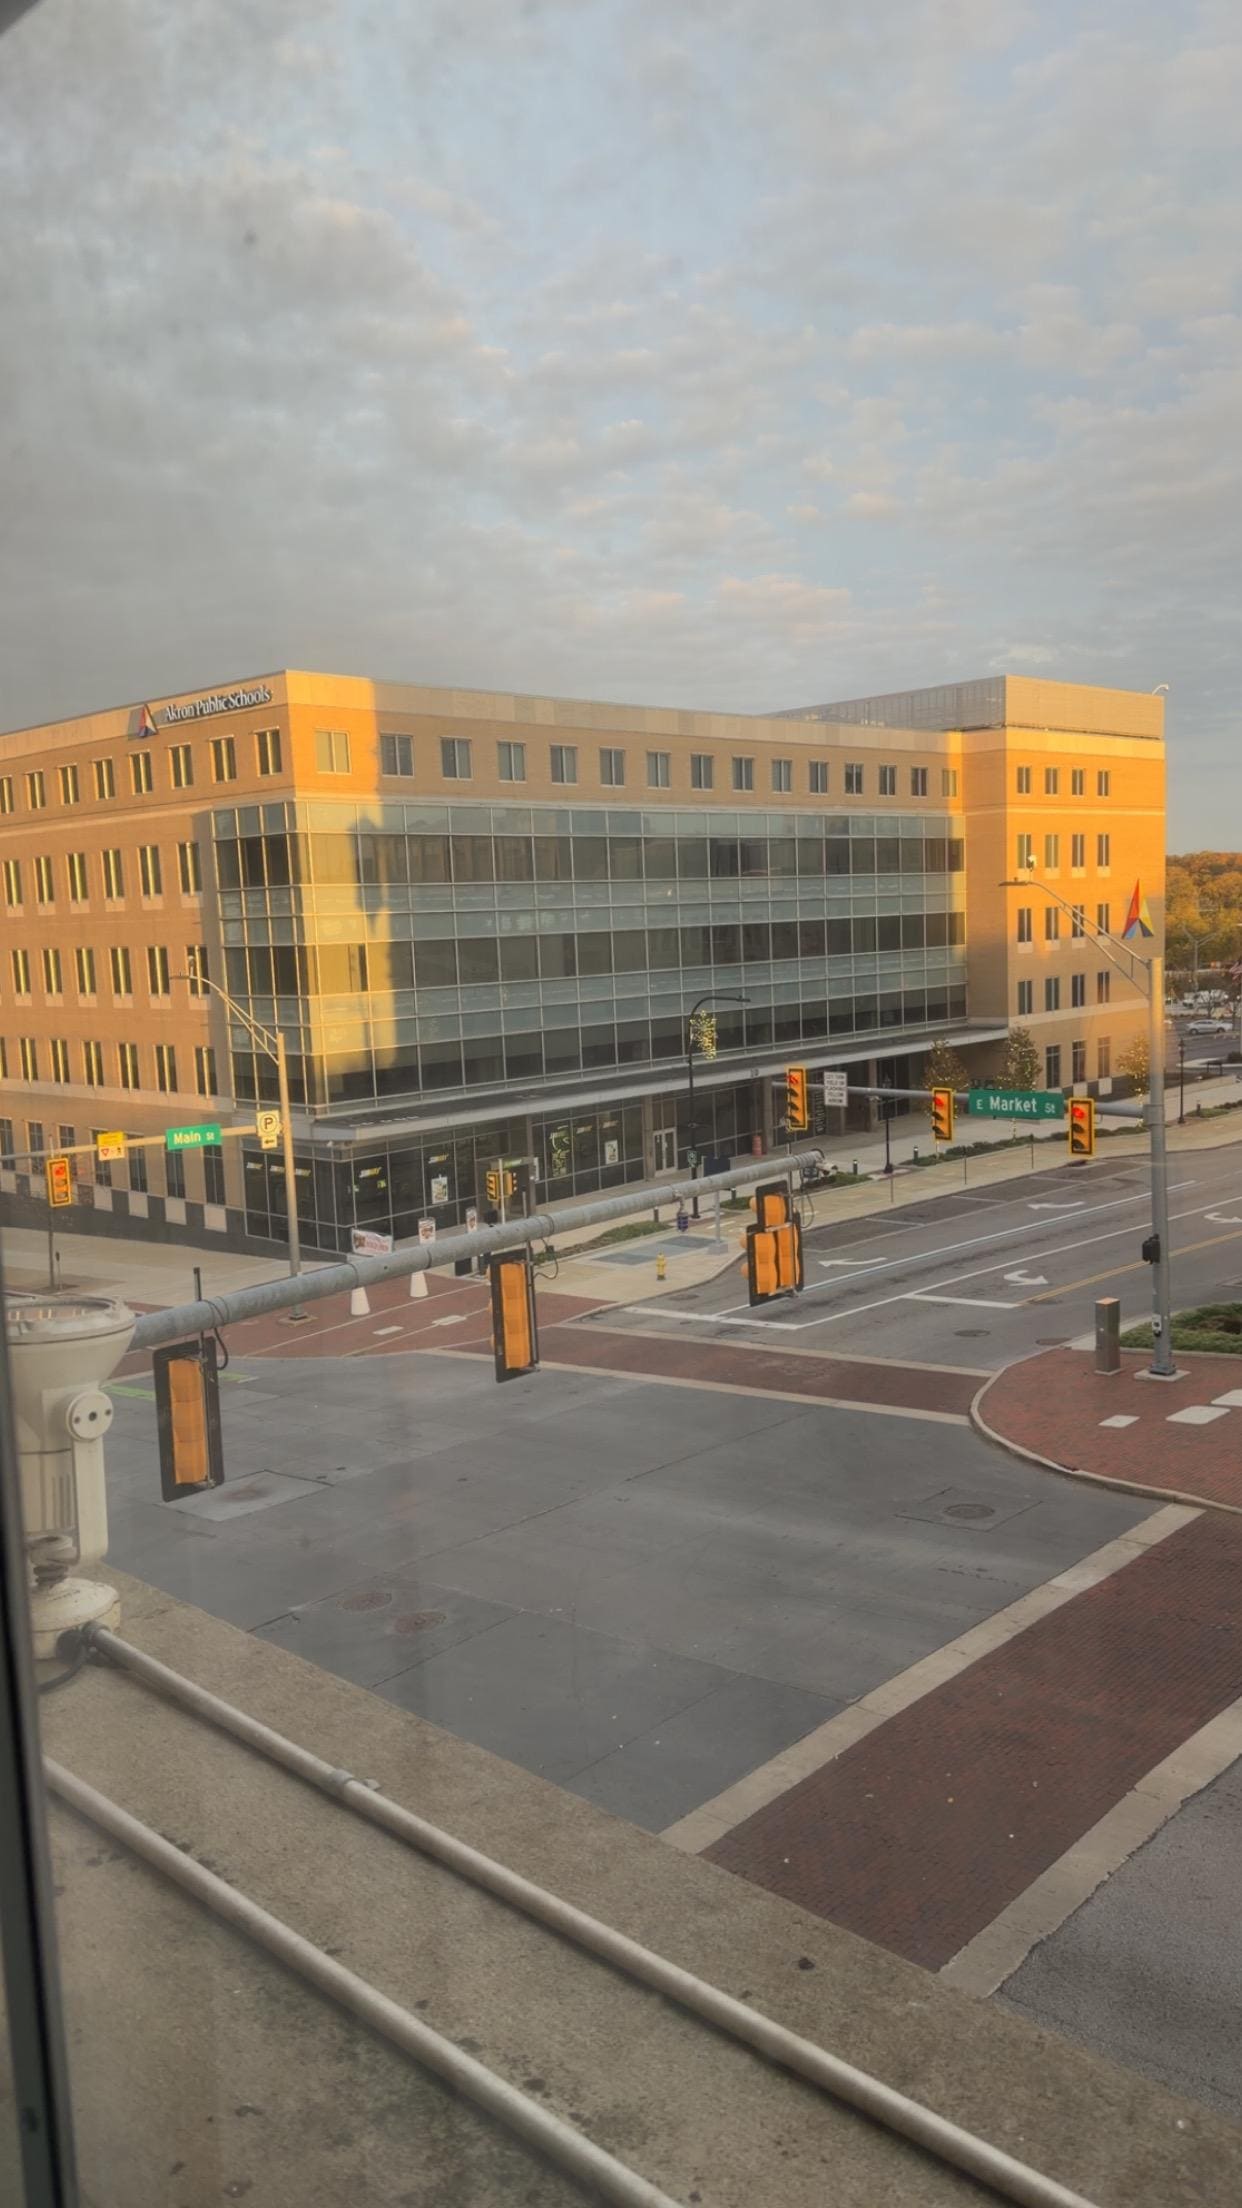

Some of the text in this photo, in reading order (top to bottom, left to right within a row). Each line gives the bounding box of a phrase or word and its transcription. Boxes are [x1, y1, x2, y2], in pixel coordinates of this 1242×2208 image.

[165, 685, 271, 721] Akron Public Schools
[976, 1095, 1056, 1114] E Market St
[264, 1117, 273, 1130] P
[173, 1131, 215, 1145] Main St
